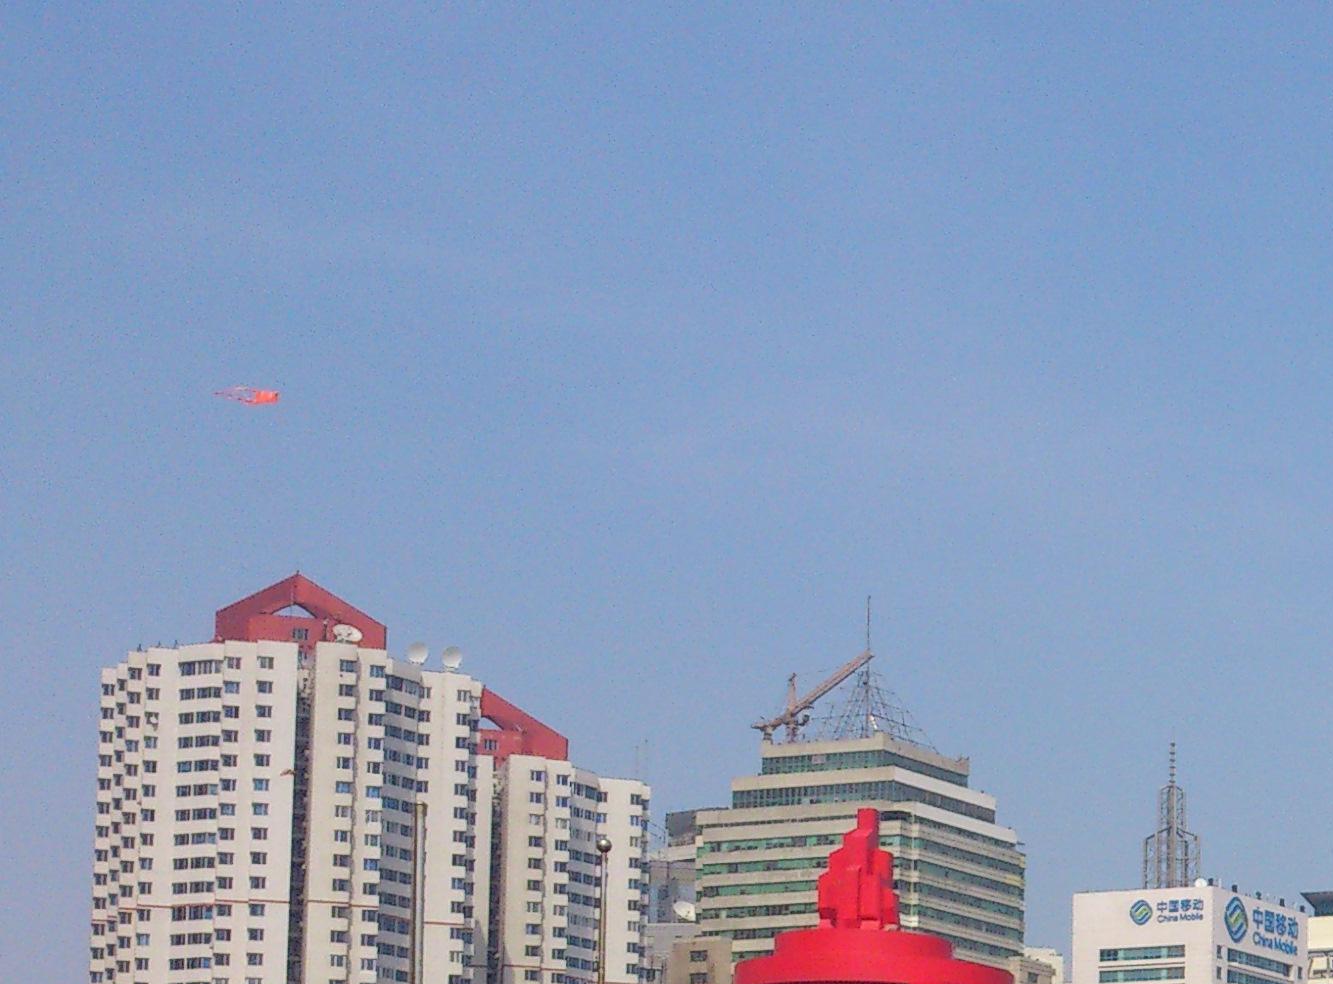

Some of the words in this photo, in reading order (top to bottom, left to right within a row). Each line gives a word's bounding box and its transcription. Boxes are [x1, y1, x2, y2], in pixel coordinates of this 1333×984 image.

[1157, 899, 1204, 912] 中国移动
[1157, 914, 1178, 923] China
[1180, 911, 1204, 921] Mobile
[1253, 908, 1298, 939] 中国移动
[1253, 931, 1273, 949] China
[1274, 937, 1298, 955] Mobile
